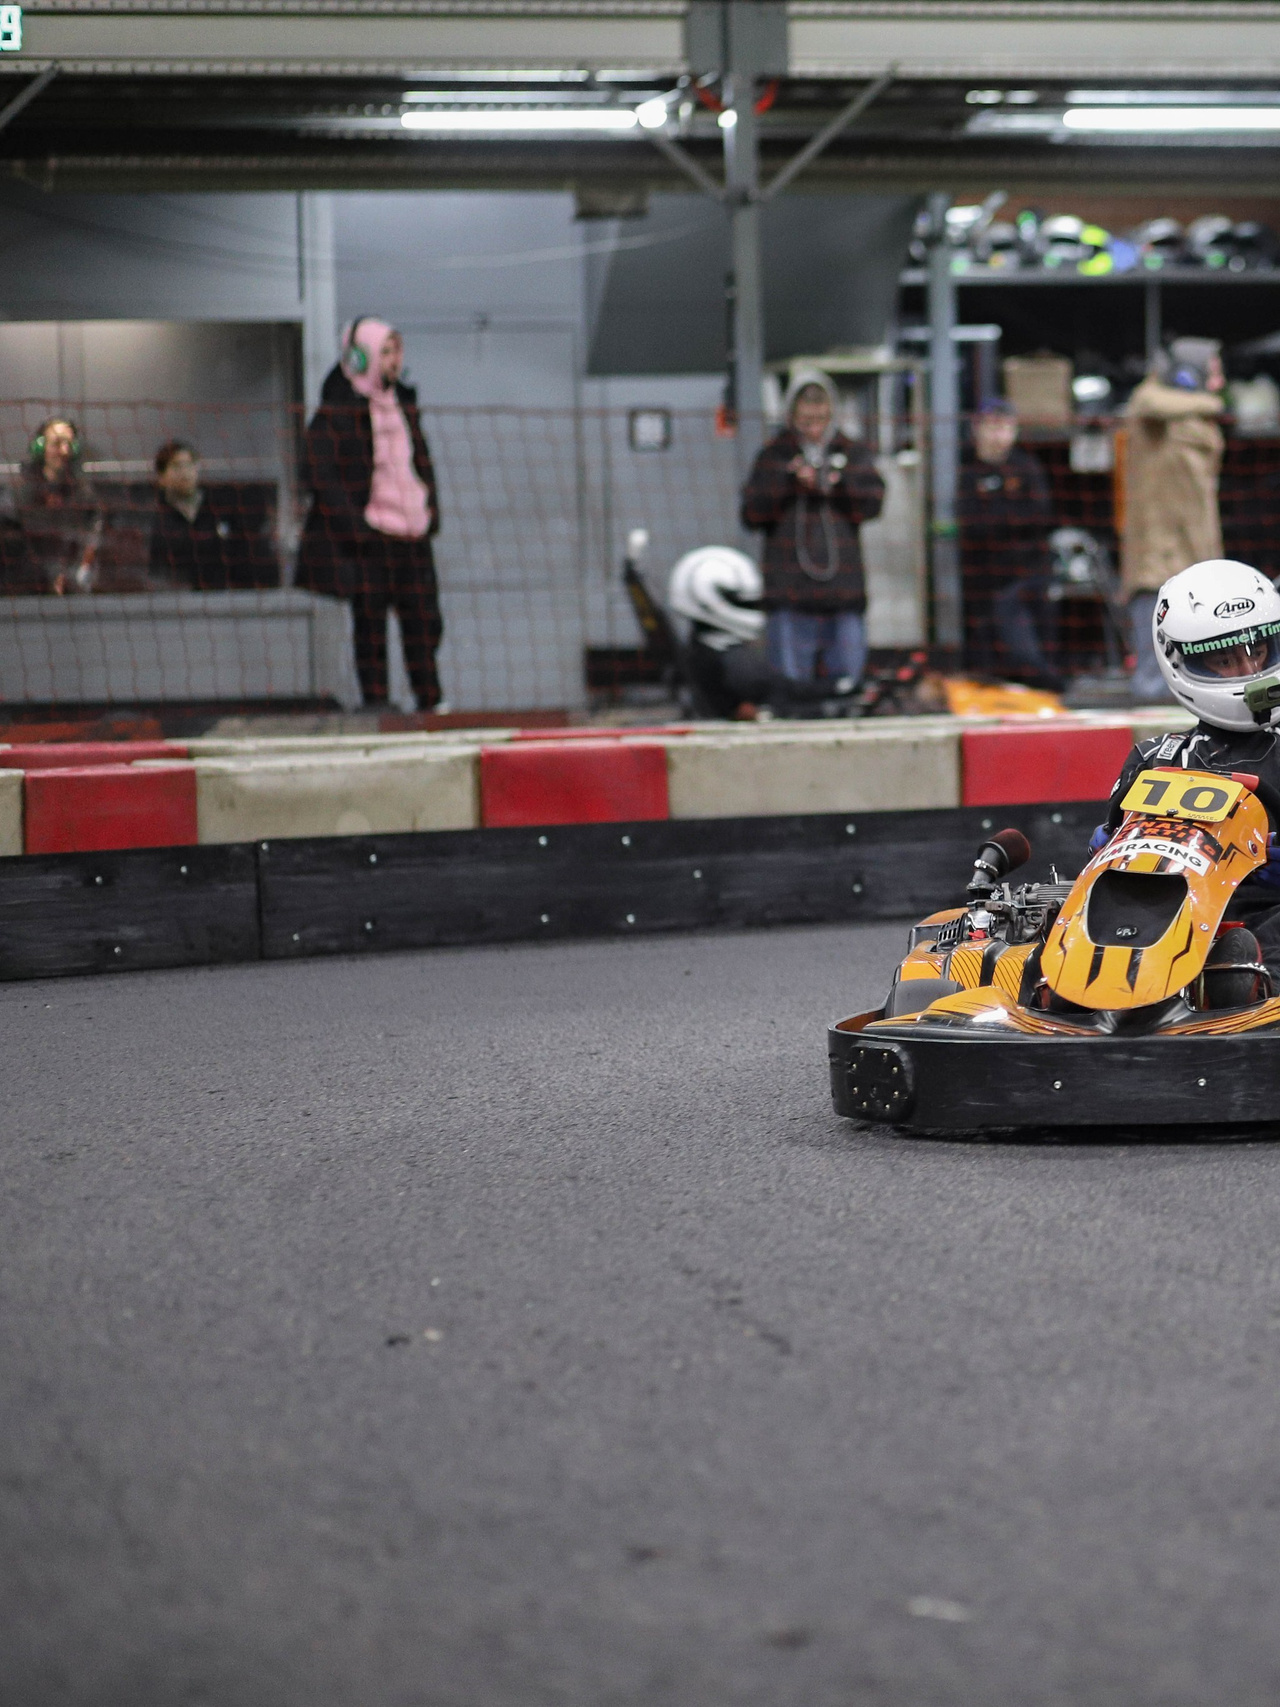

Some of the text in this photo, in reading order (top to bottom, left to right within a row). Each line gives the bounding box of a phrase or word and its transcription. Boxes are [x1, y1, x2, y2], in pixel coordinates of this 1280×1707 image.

[1217, 599, 1251, 616] Arai
[1181, 629, 1258, 656] Hammer
[1141, 778, 1229, 813] 10
